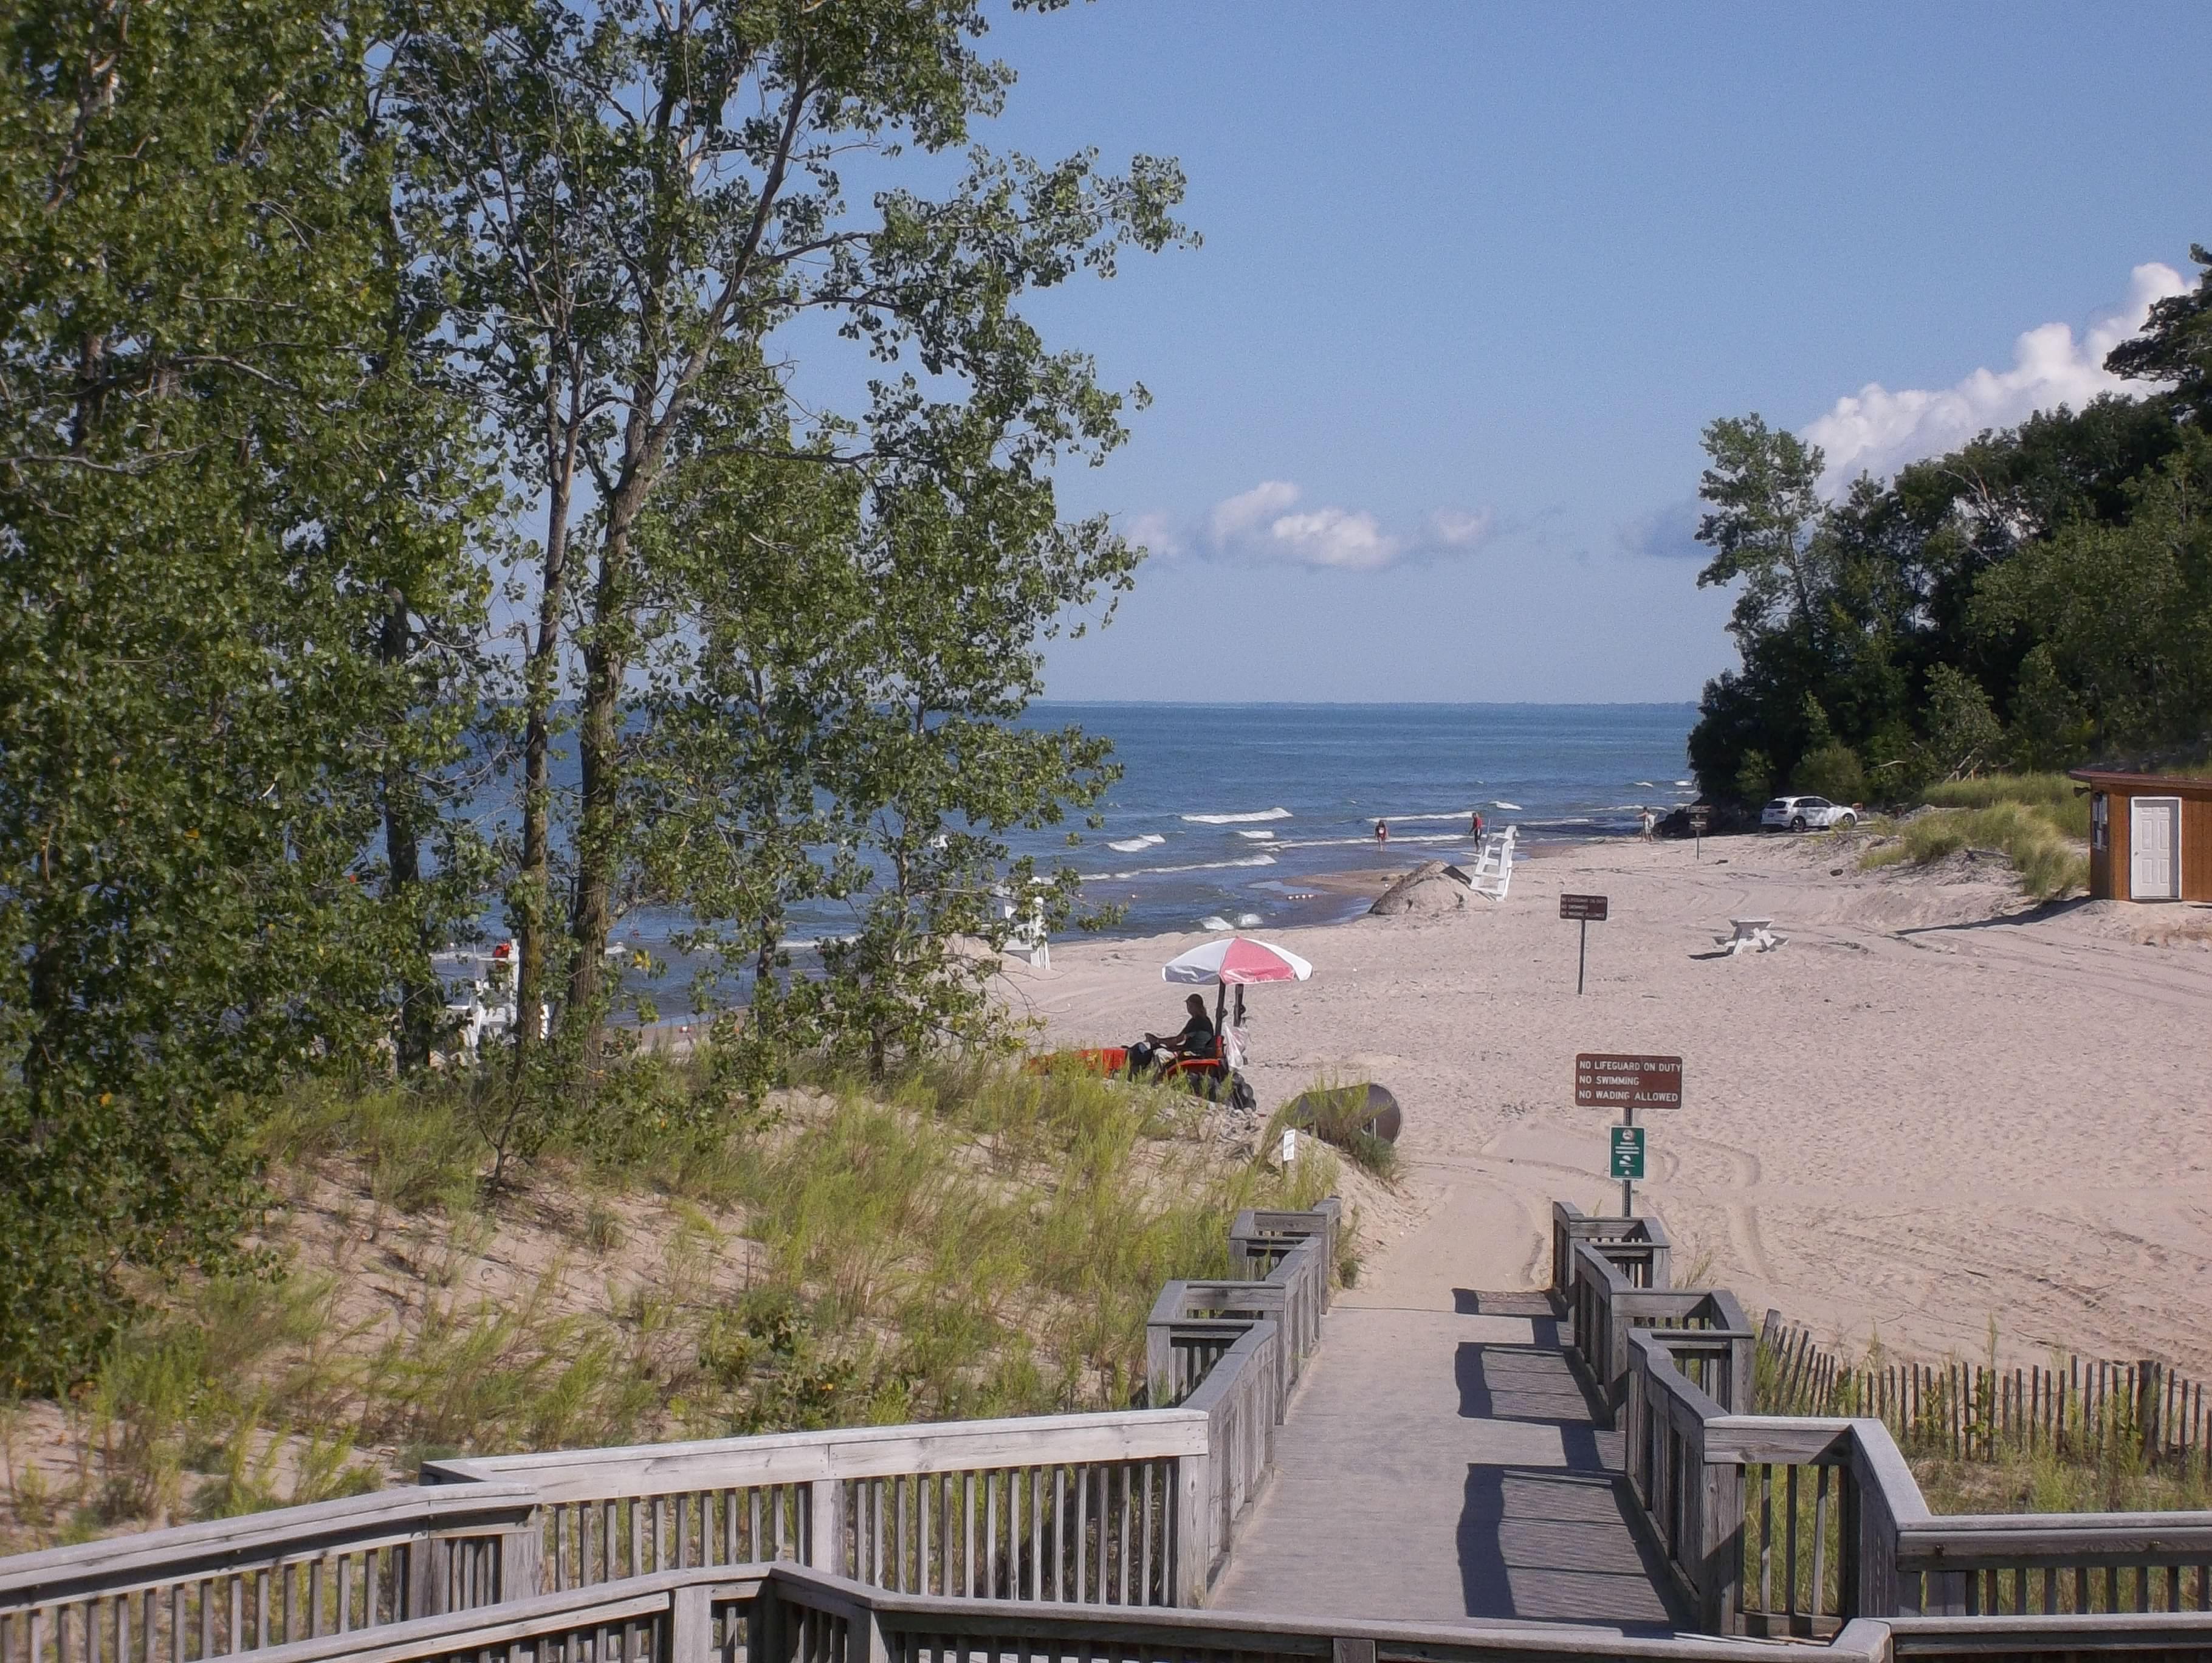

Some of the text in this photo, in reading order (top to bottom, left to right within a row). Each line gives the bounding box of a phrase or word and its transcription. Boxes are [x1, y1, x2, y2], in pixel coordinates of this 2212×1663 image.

[1579, 1061, 1591, 1069] NO
[1595, 1061, 1640, 1070] LIFEGUARD
[1579, 1075, 1640, 1085] NO SWIMMING
[1596, 1091, 1630, 1100] WADING
[1634, 1092, 1678, 1101] ALLOWED
